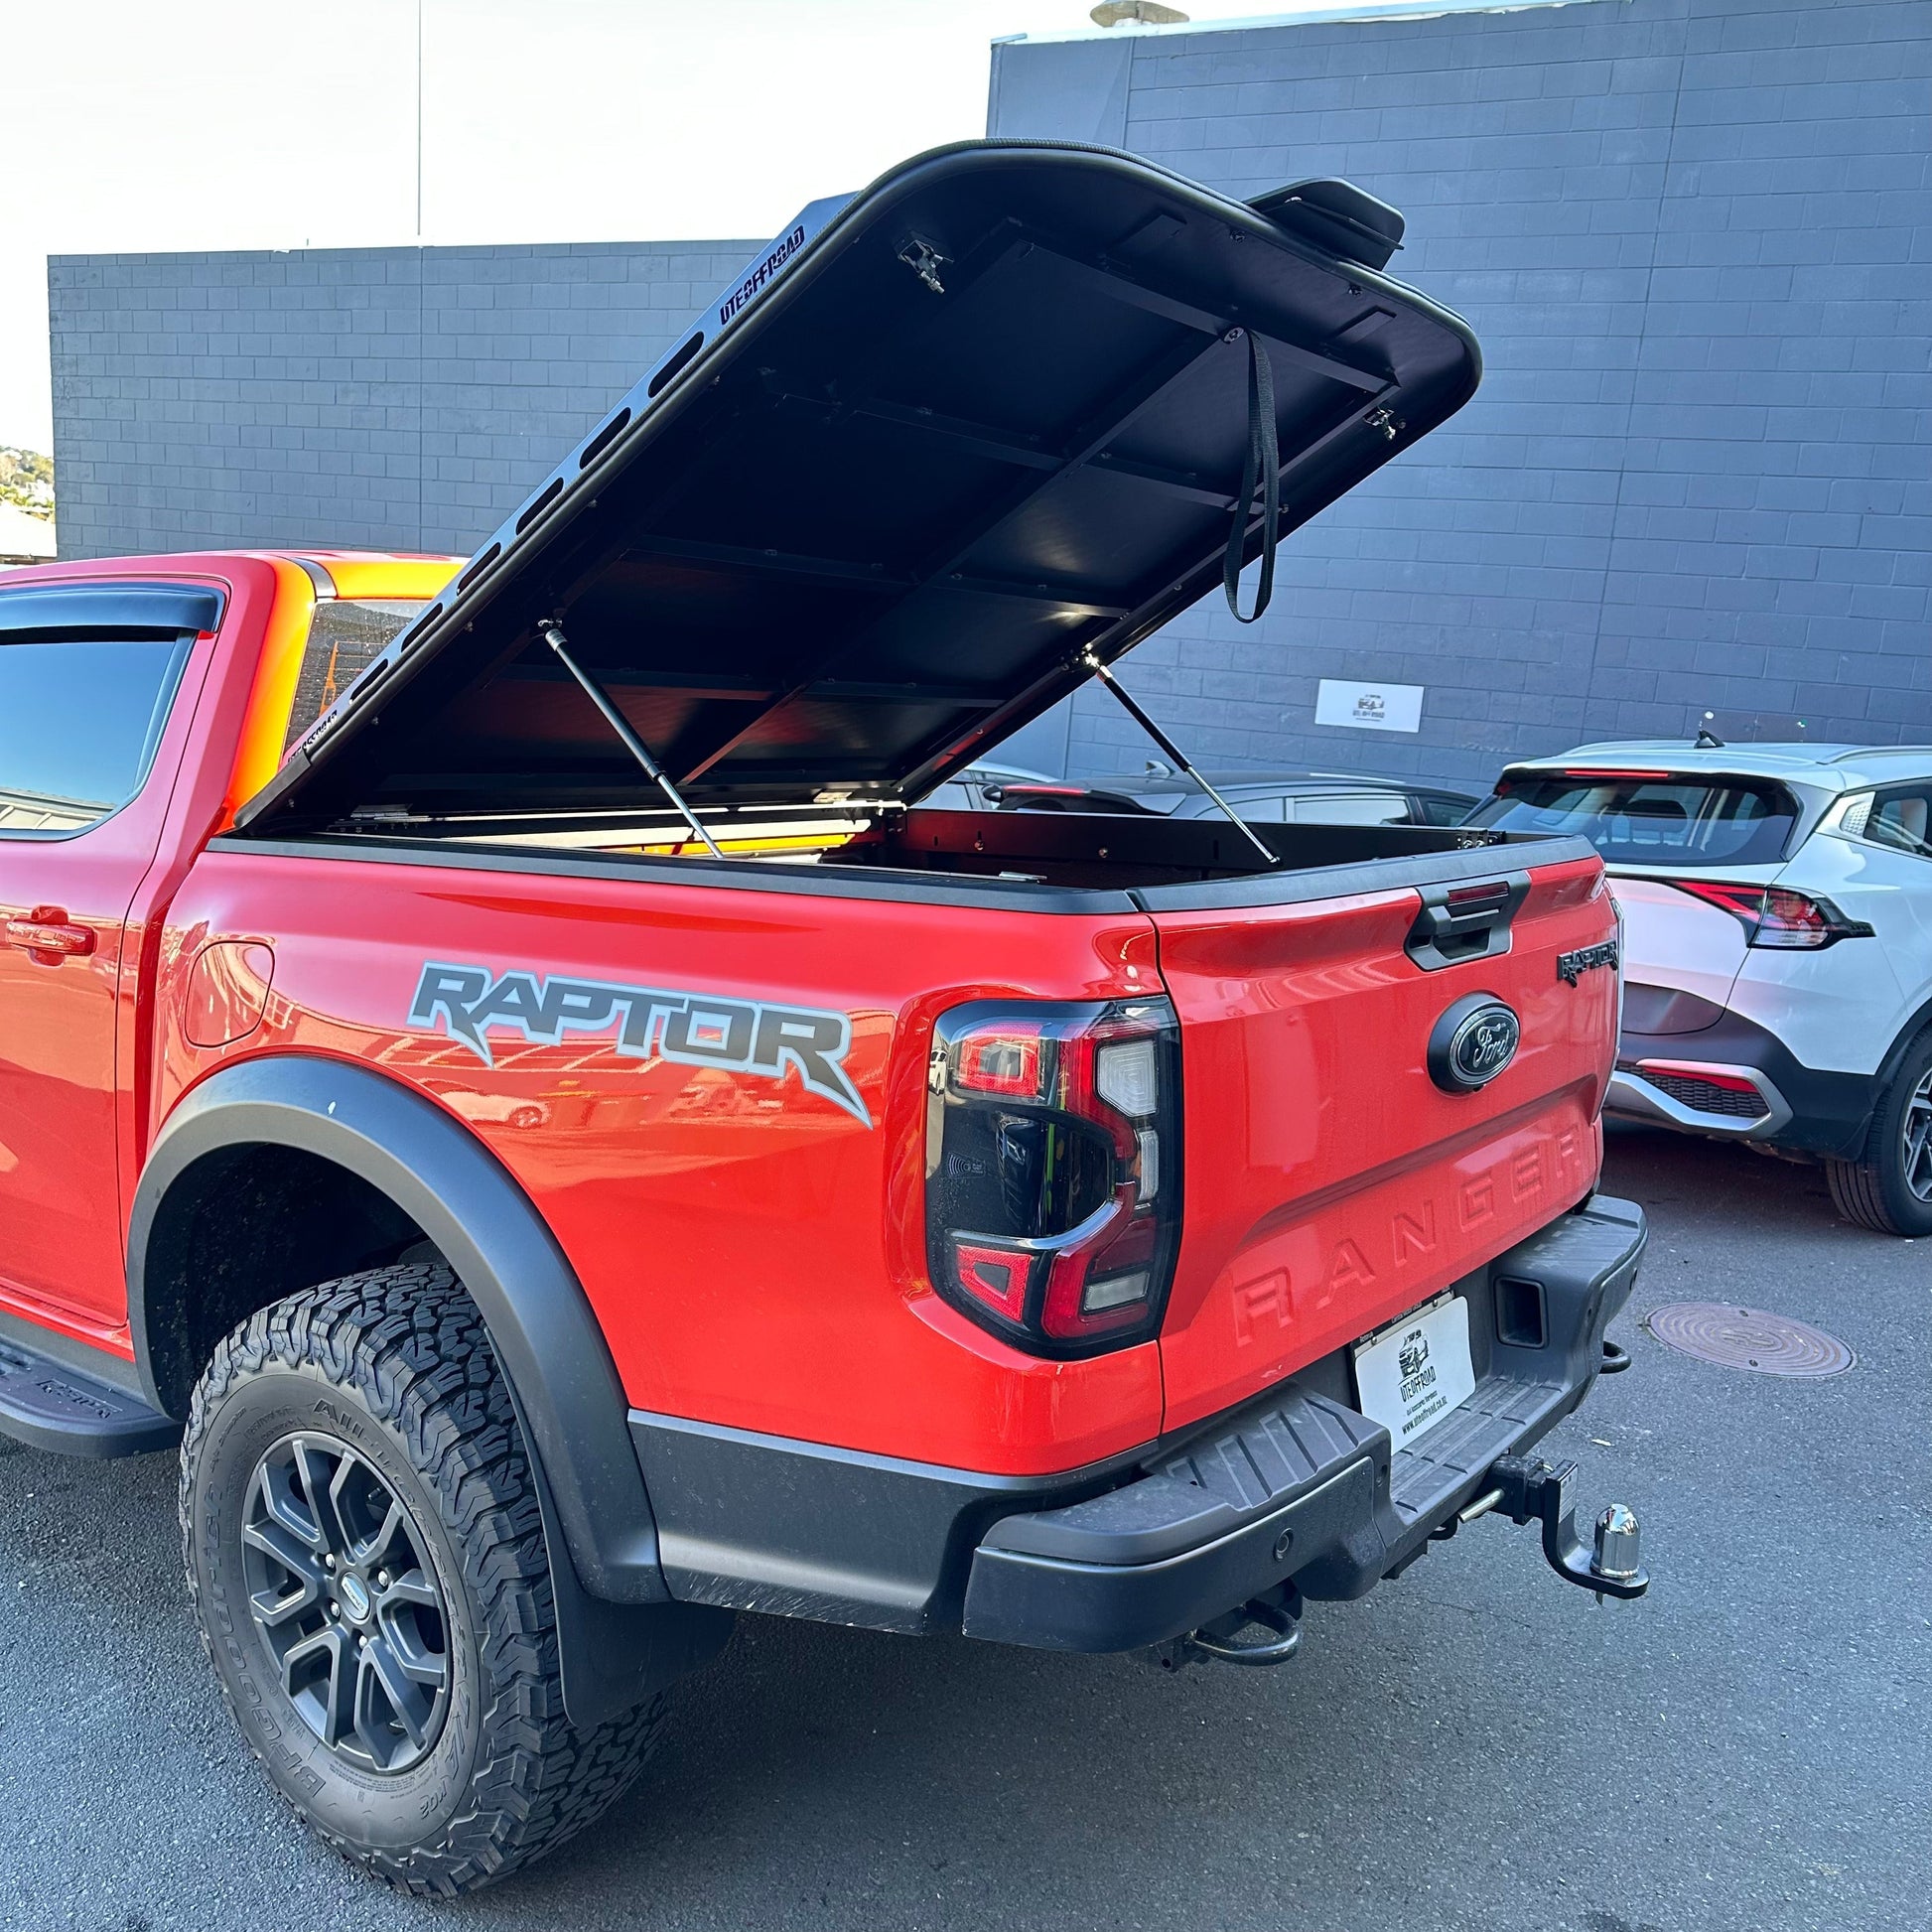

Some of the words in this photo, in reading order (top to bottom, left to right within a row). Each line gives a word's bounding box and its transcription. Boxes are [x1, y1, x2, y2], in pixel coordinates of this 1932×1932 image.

[1557, 937, 1619, 988] RAPTOR
[405, 960, 873, 1130] RAPTOR
[1472, 1022, 1510, 1068] Ford
[1233, 1122, 1584, 1348] RANGER
[1400, 1365, 1437, 1403] UTEOFFROAD
